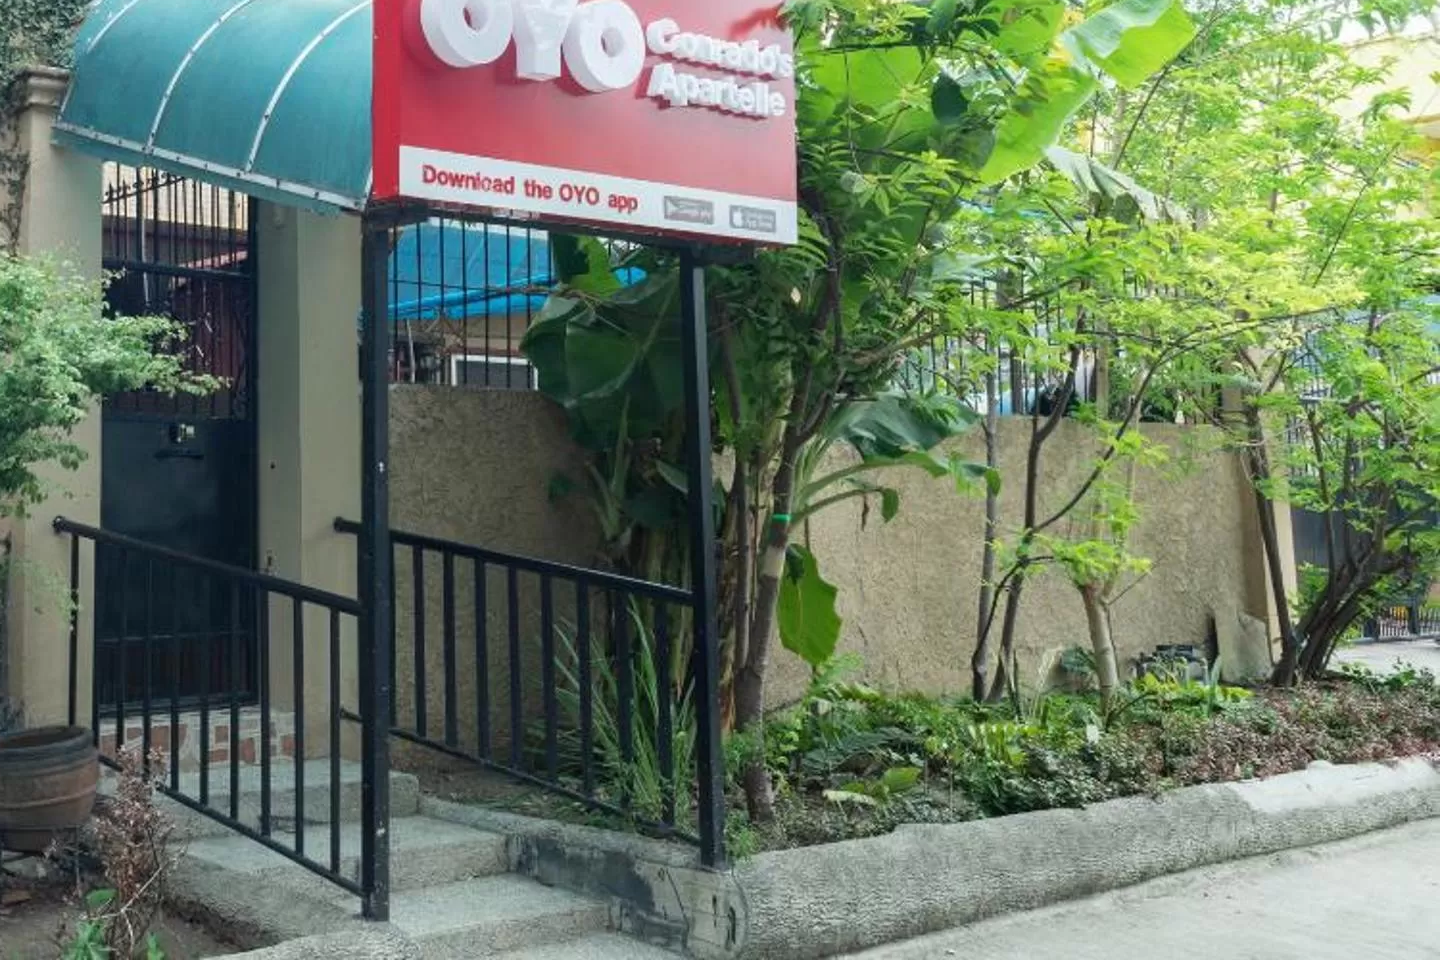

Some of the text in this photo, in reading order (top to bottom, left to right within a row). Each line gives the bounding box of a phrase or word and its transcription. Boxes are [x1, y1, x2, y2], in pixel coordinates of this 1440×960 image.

[646, 17, 793, 77] Conrado's
[646, 62, 786, 117] Apartelle
[422, 164, 639, 214] Download the OYO app
